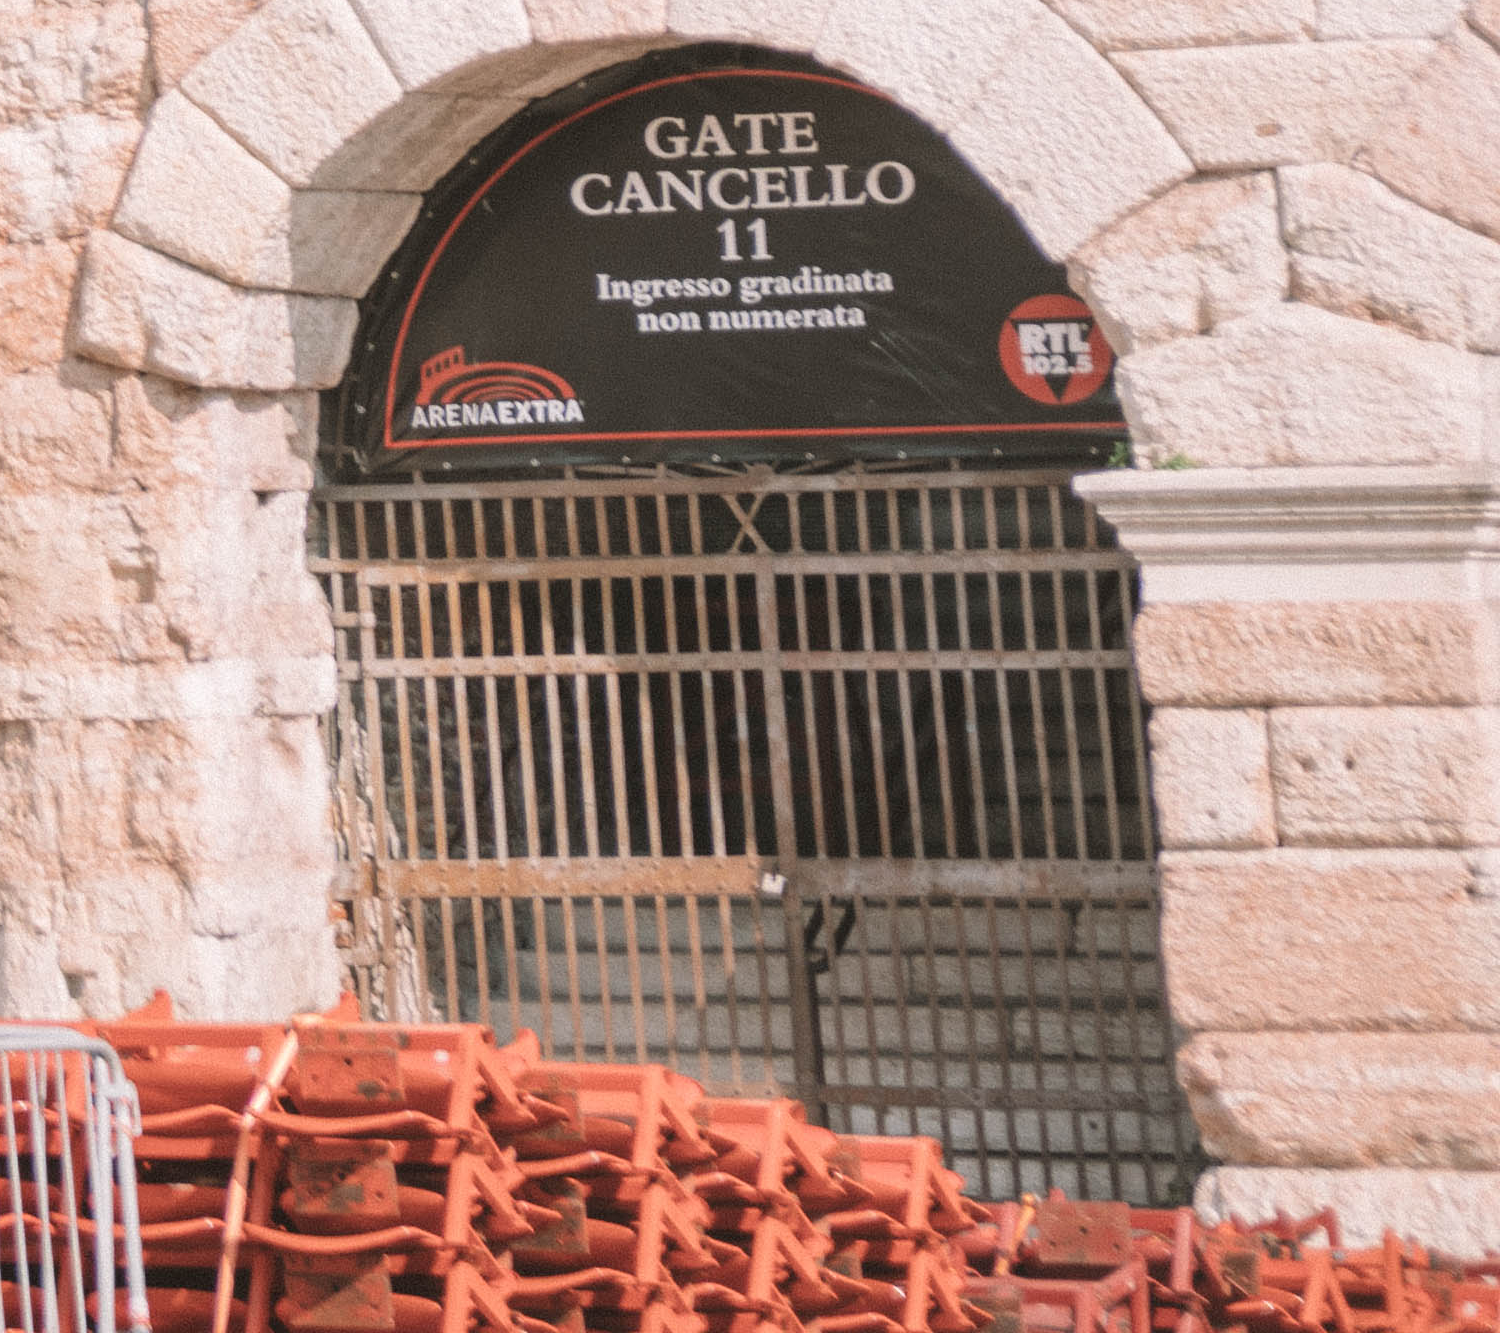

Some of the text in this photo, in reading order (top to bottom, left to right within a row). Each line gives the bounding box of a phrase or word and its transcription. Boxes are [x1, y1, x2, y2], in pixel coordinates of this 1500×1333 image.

[644, 112, 819, 161] GATE
[569, 161, 915, 217] CANCELLO
[715, 218, 772, 262] 11
[595, 266, 894, 307] Ingresso gradinata
[637, 303, 868, 334] non numerata
[1018, 323, 1092, 354] RTL
[1022, 354, 1094, 375] 102.5
[411, 398, 585, 428] ARENAEXTRA
